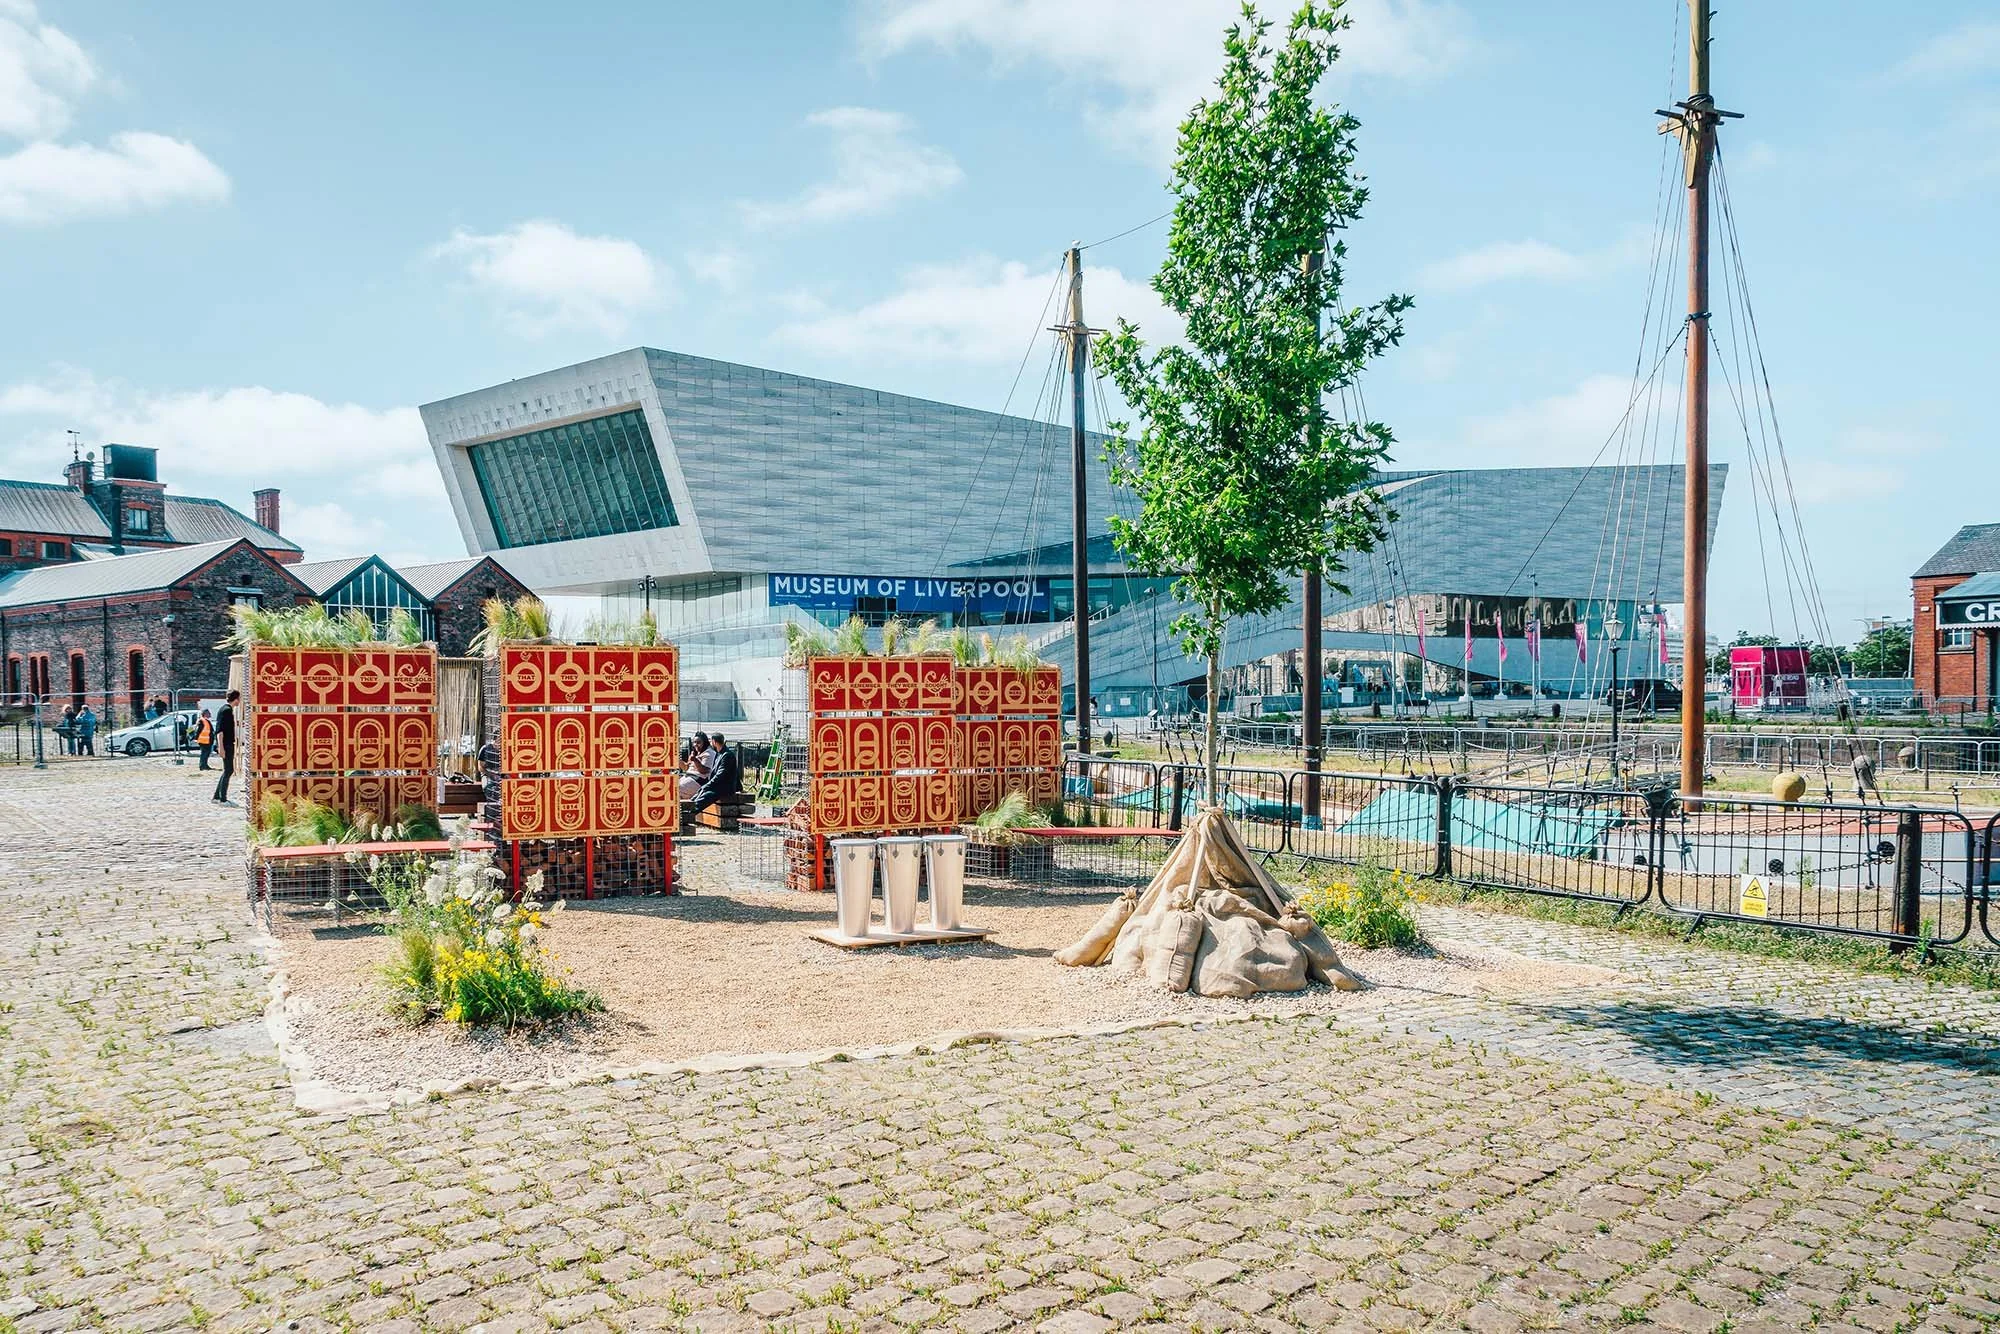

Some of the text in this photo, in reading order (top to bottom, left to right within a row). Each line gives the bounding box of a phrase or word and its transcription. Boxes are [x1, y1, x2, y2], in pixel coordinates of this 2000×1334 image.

[774, 576, 1044, 598] MUSEUM OF LIVERPOOL
[1965, 602, 2000, 621] GR
